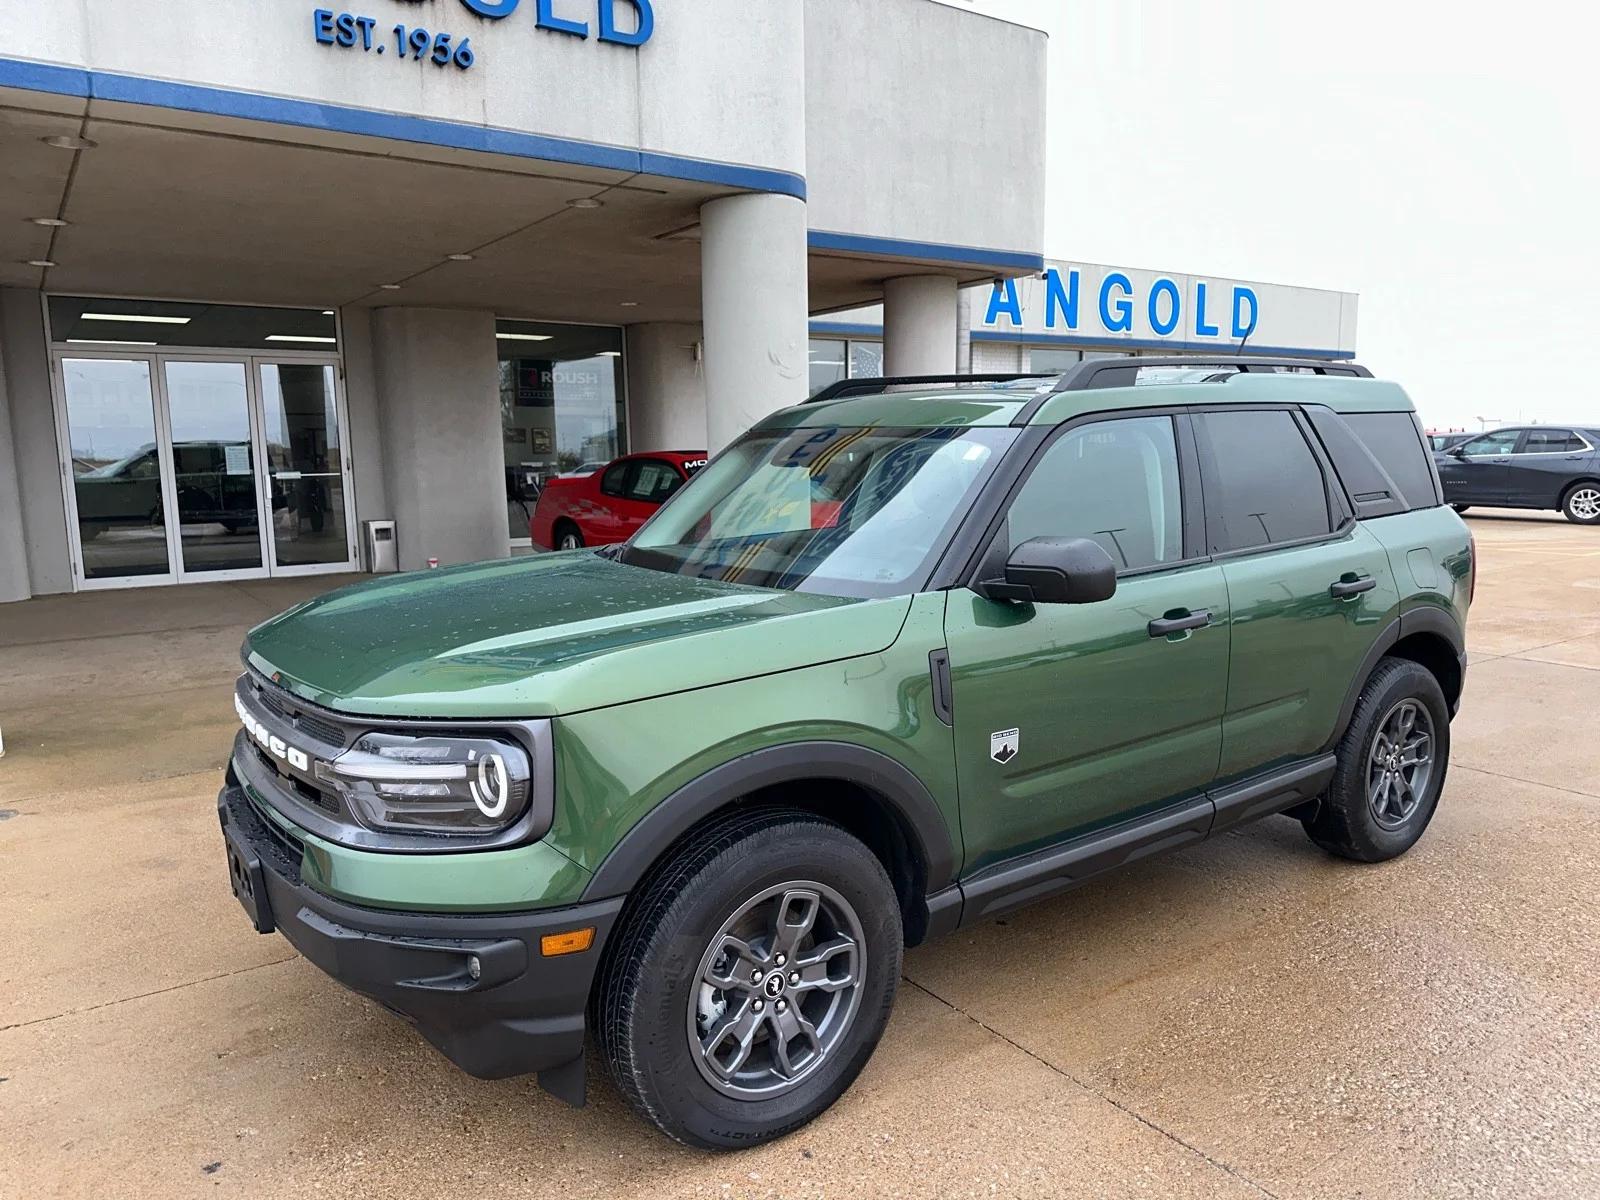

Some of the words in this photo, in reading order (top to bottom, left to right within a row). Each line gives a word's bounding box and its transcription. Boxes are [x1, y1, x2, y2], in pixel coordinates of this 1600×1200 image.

[313, 9, 385, 54] EST.
[393, 24, 475, 70] 1956
[984, 264, 1259, 340] ANGOLD
[541, 371, 598, 385] ROUSH
